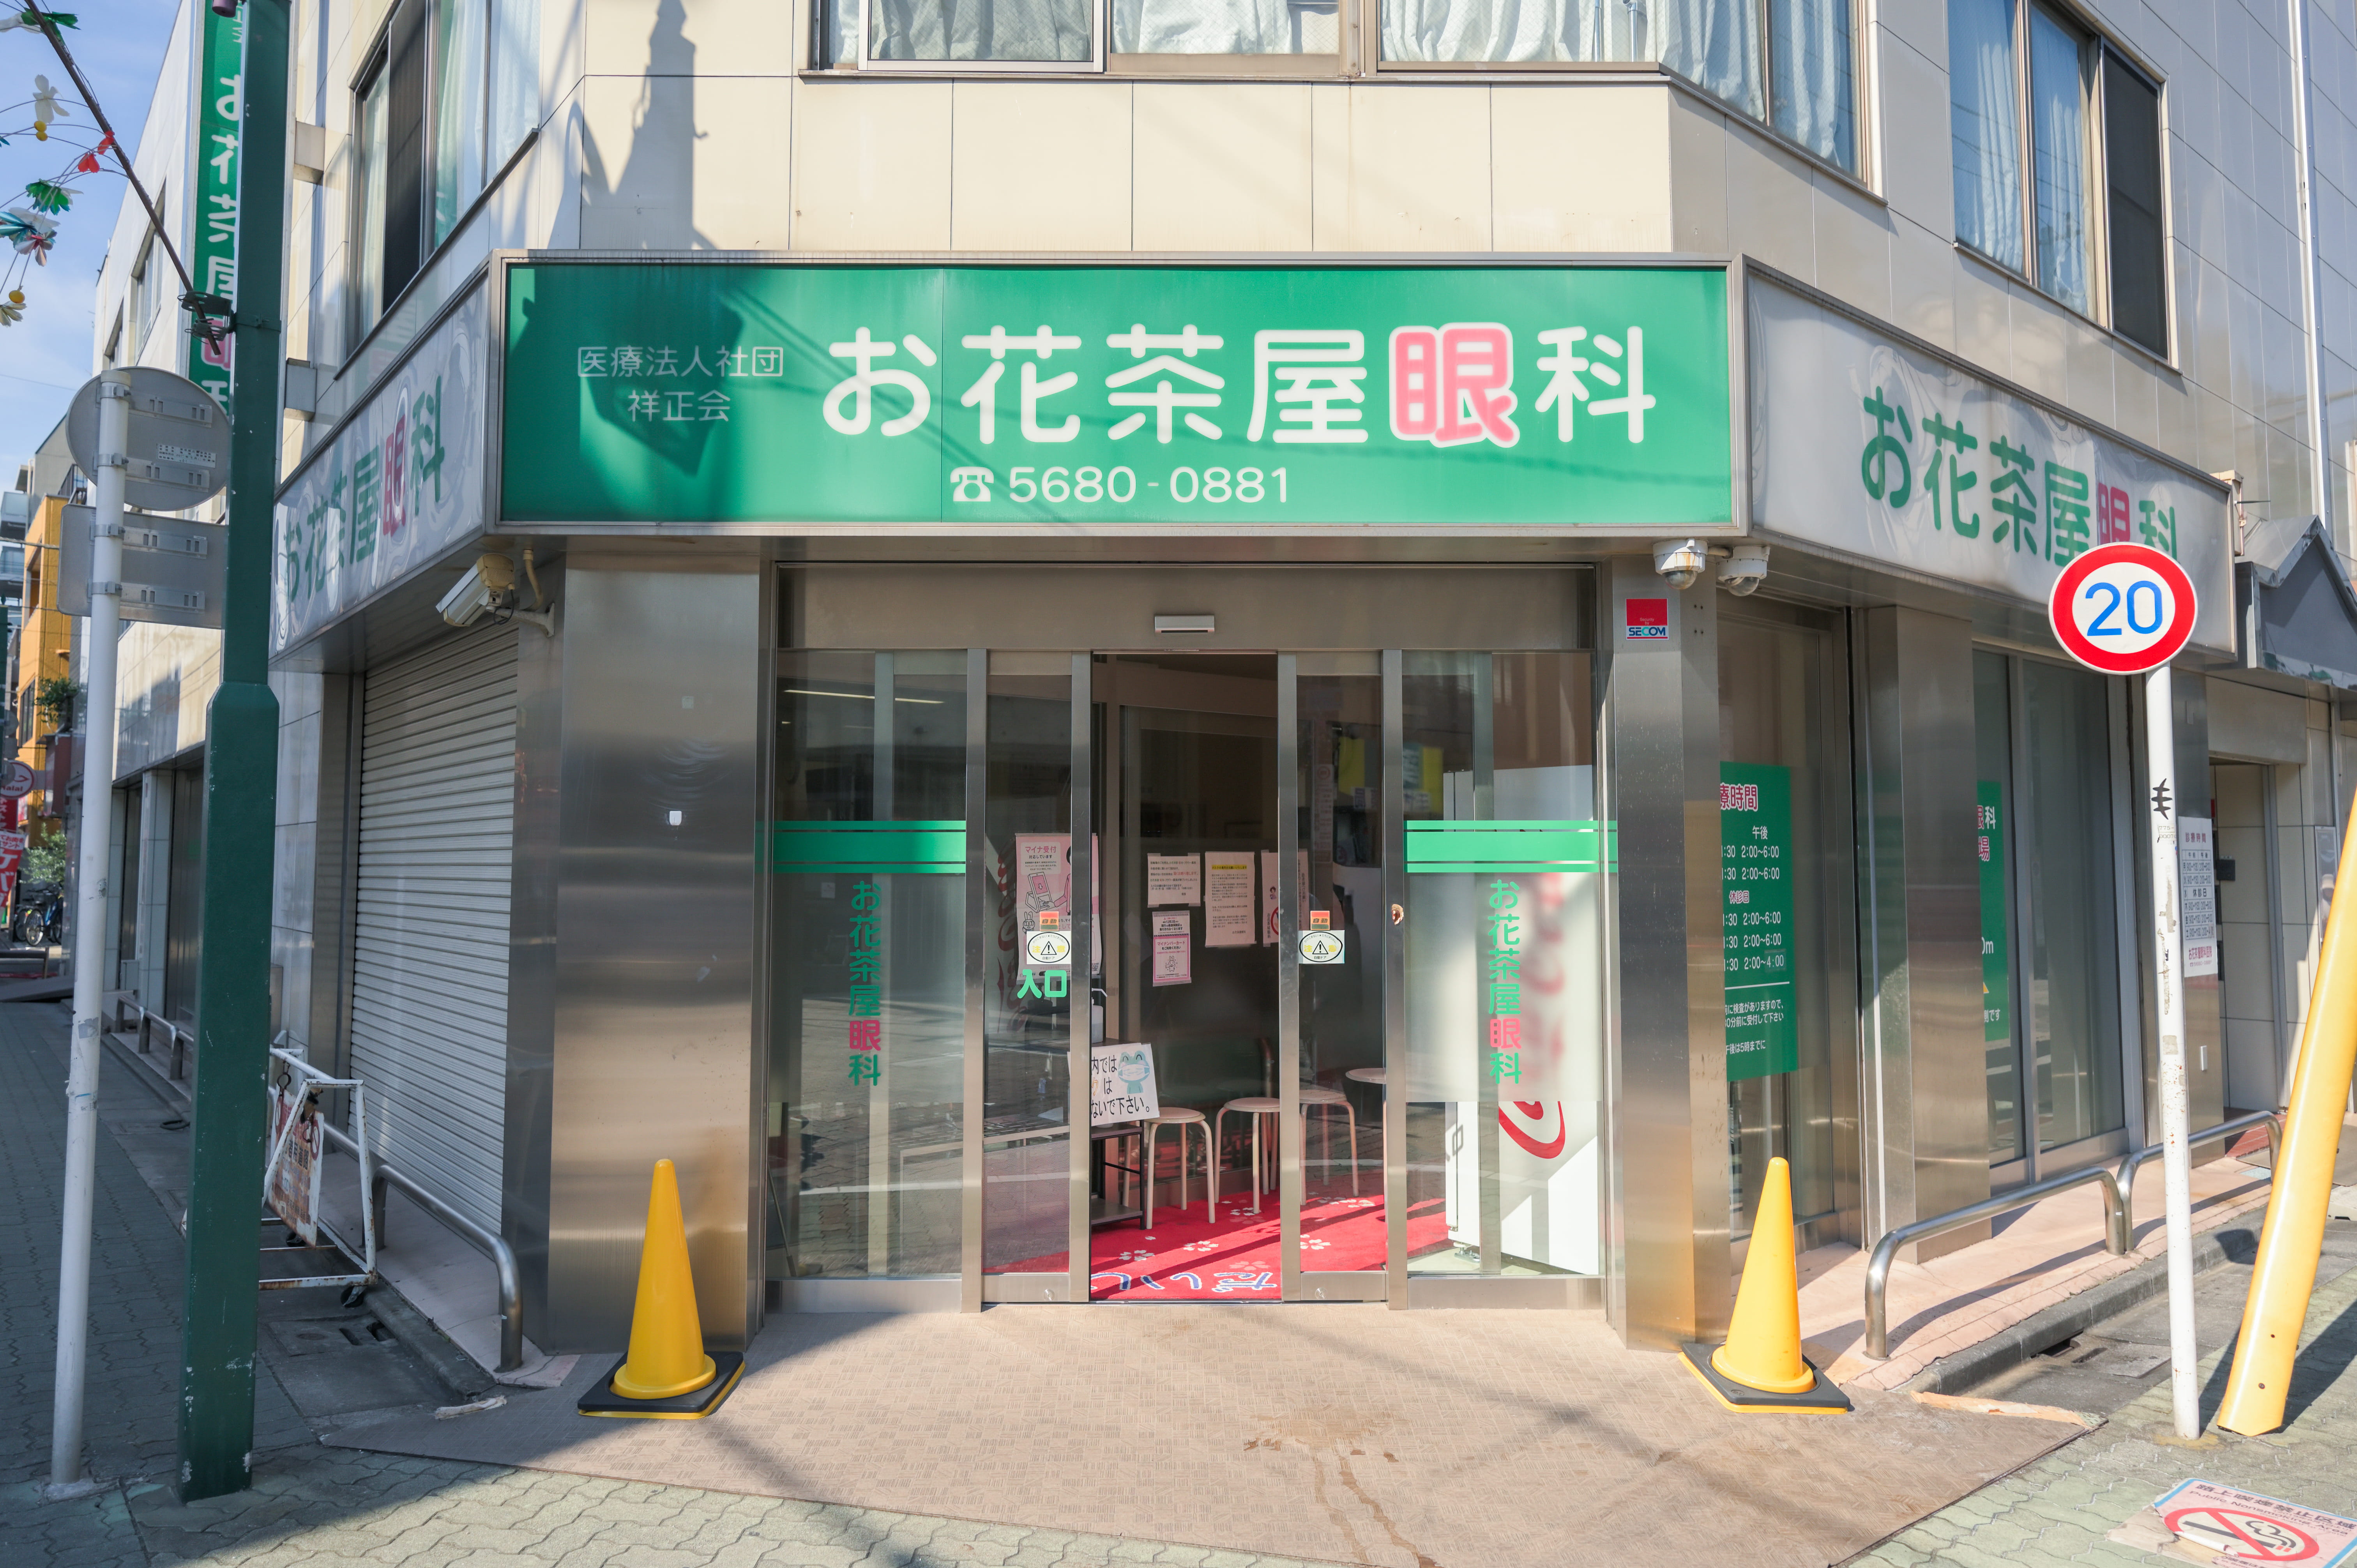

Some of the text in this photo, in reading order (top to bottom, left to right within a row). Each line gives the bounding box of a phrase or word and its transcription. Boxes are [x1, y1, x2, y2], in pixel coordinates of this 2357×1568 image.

[578, 345, 784, 378] 医療法人社団
[823, 322, 1656, 449] お花茶屋眼科
[628, 389, 731, 422] 祥正会
[284, 376, 445, 602] お花茶屋眼科
[2085, 580, 2163, 636] 20
[1629, 627, 1666, 636] SECOM
[1752, 825, 1768, 840] 午後
[1729, 890, 1749, 904] 休診日
[2193, 888, 2207, 897] 休診日
[848, 881, 882, 1086] お花茶屋眼科
[1017, 969, 1067, 999] 入口
[1488, 879, 1522, 1084] お花茶屋眼科
[1091, 1054, 1117, 1075] 内では
[1104, 1077, 1112, 1095] は
[2189, 1490, 2227, 1504] Public
[2316, 1524, 2348, 1535] Area
[2195, 1483, 2357, 1529] 路上喫煙禁止区域
